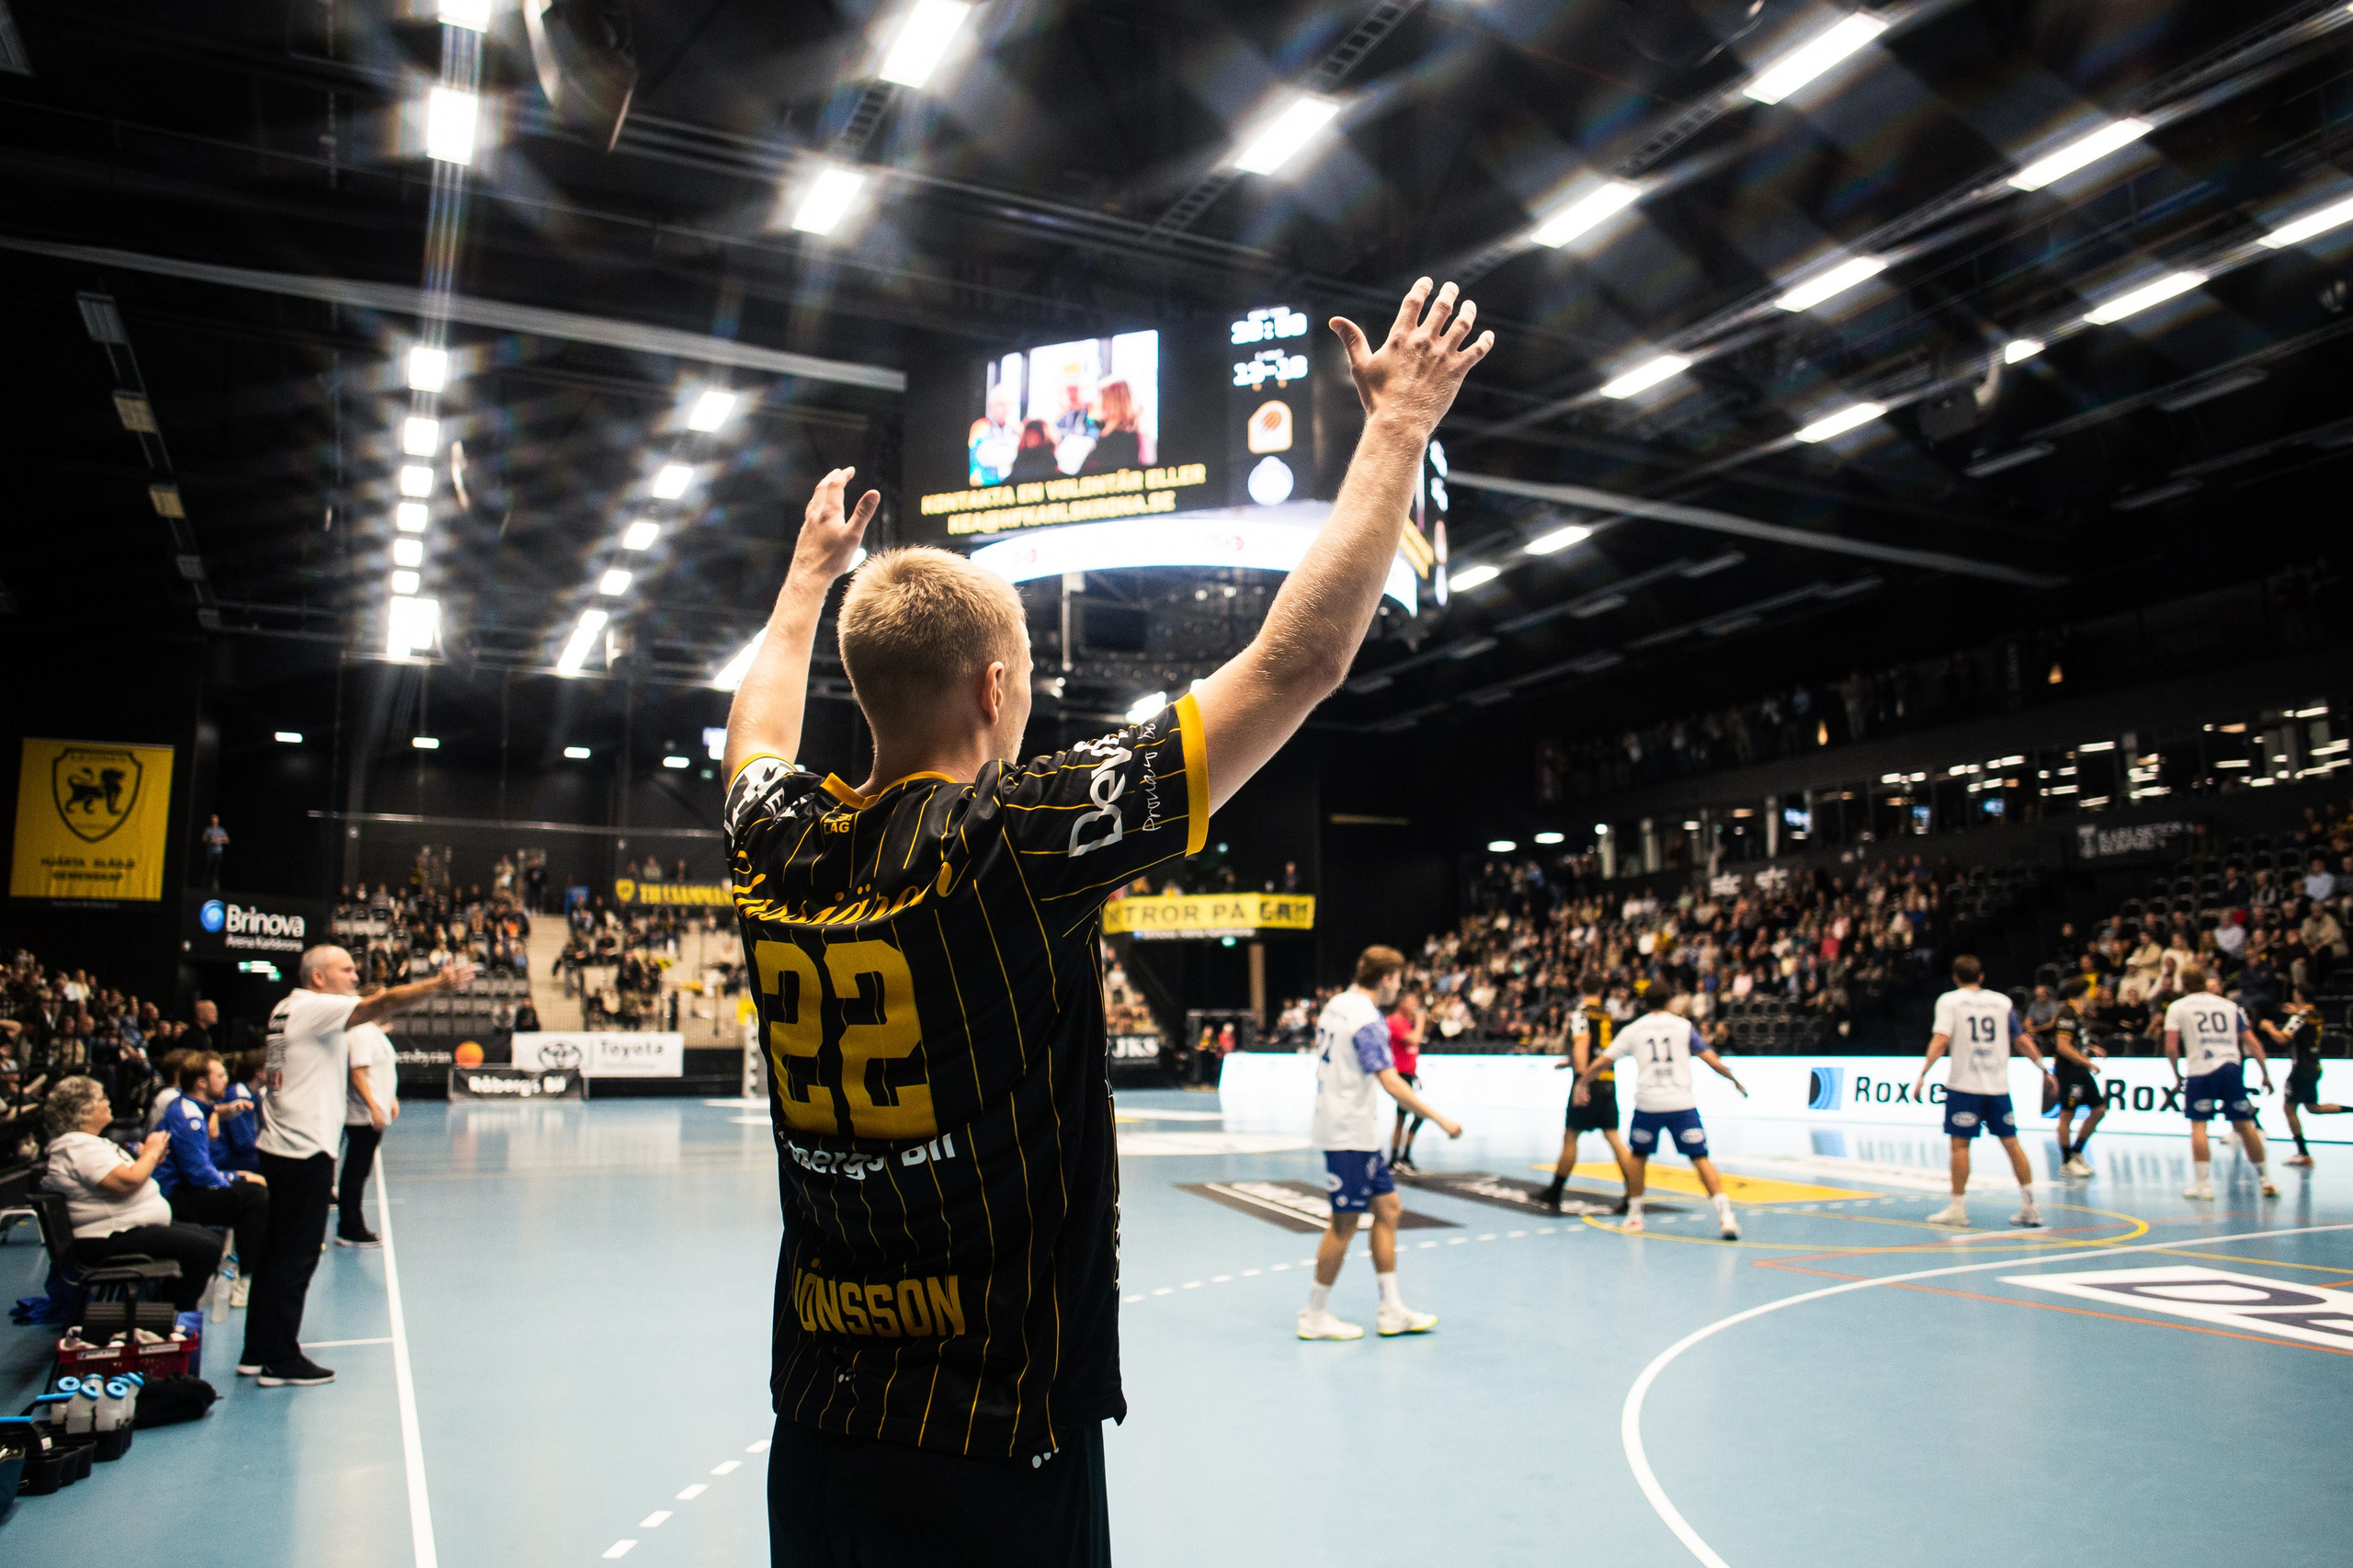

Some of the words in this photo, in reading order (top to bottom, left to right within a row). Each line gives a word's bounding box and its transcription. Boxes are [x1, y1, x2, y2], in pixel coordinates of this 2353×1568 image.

[226, 904, 305, 937] Brinova
[1125, 903, 1199, 924] TROR
[1968, 1017, 1995, 1042] 19
[2196, 1011, 2228, 1033] 20
[754, 938, 938, 1139] 22
[1111, 1037, 1159, 1058] JKS
[1648, 1038, 1673, 1062] 11
[600, 1039, 665, 1062] Toyota
[468, 1075, 542, 1097] Råbergs
[1855, 1076, 1948, 1104] Roxe
